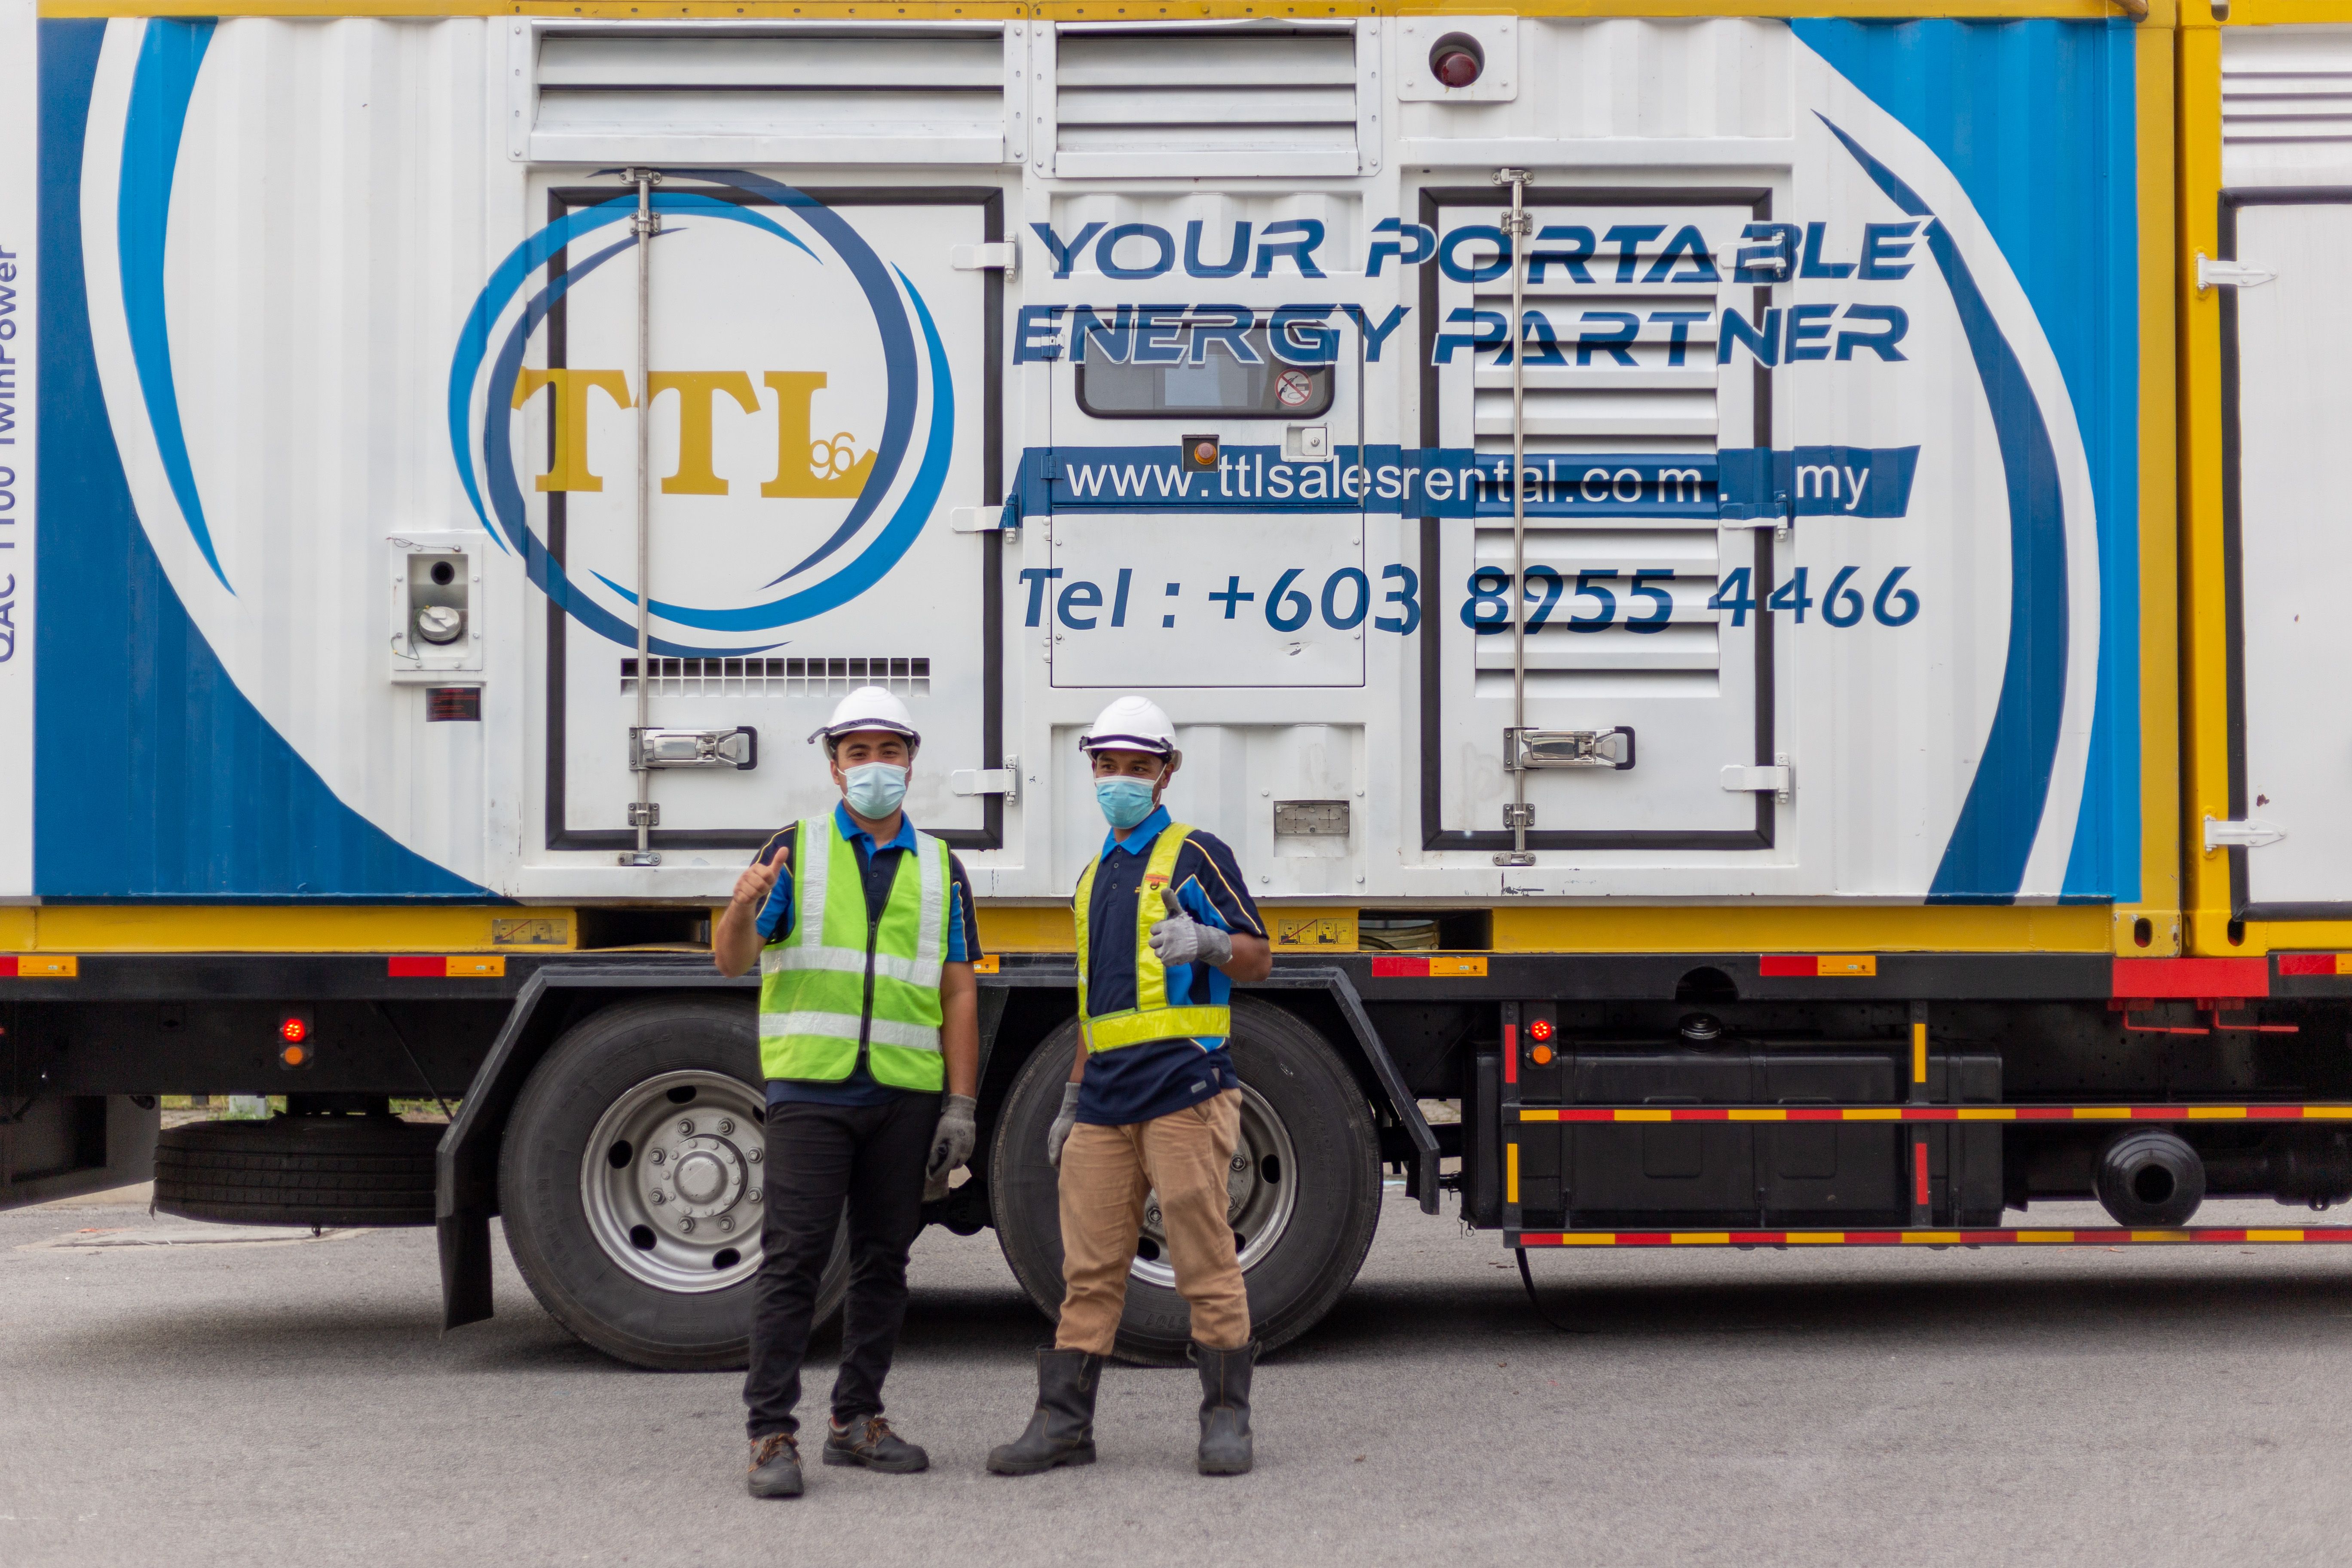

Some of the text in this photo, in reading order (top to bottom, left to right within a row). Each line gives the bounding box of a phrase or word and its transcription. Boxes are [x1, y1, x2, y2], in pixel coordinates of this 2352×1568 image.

[1029, 217, 1921, 284] YOUR PORTABLE
[1013, 303, 1910, 368] ENERGY PARTNER
[511, 366, 878, 499] TTL
[1208, 564, 1421, 636] +603
[1460, 565, 1675, 635] 8955
[1707, 565, 1921, 628] 4466
[536, 1178, 573, 1269] KAPSEN
